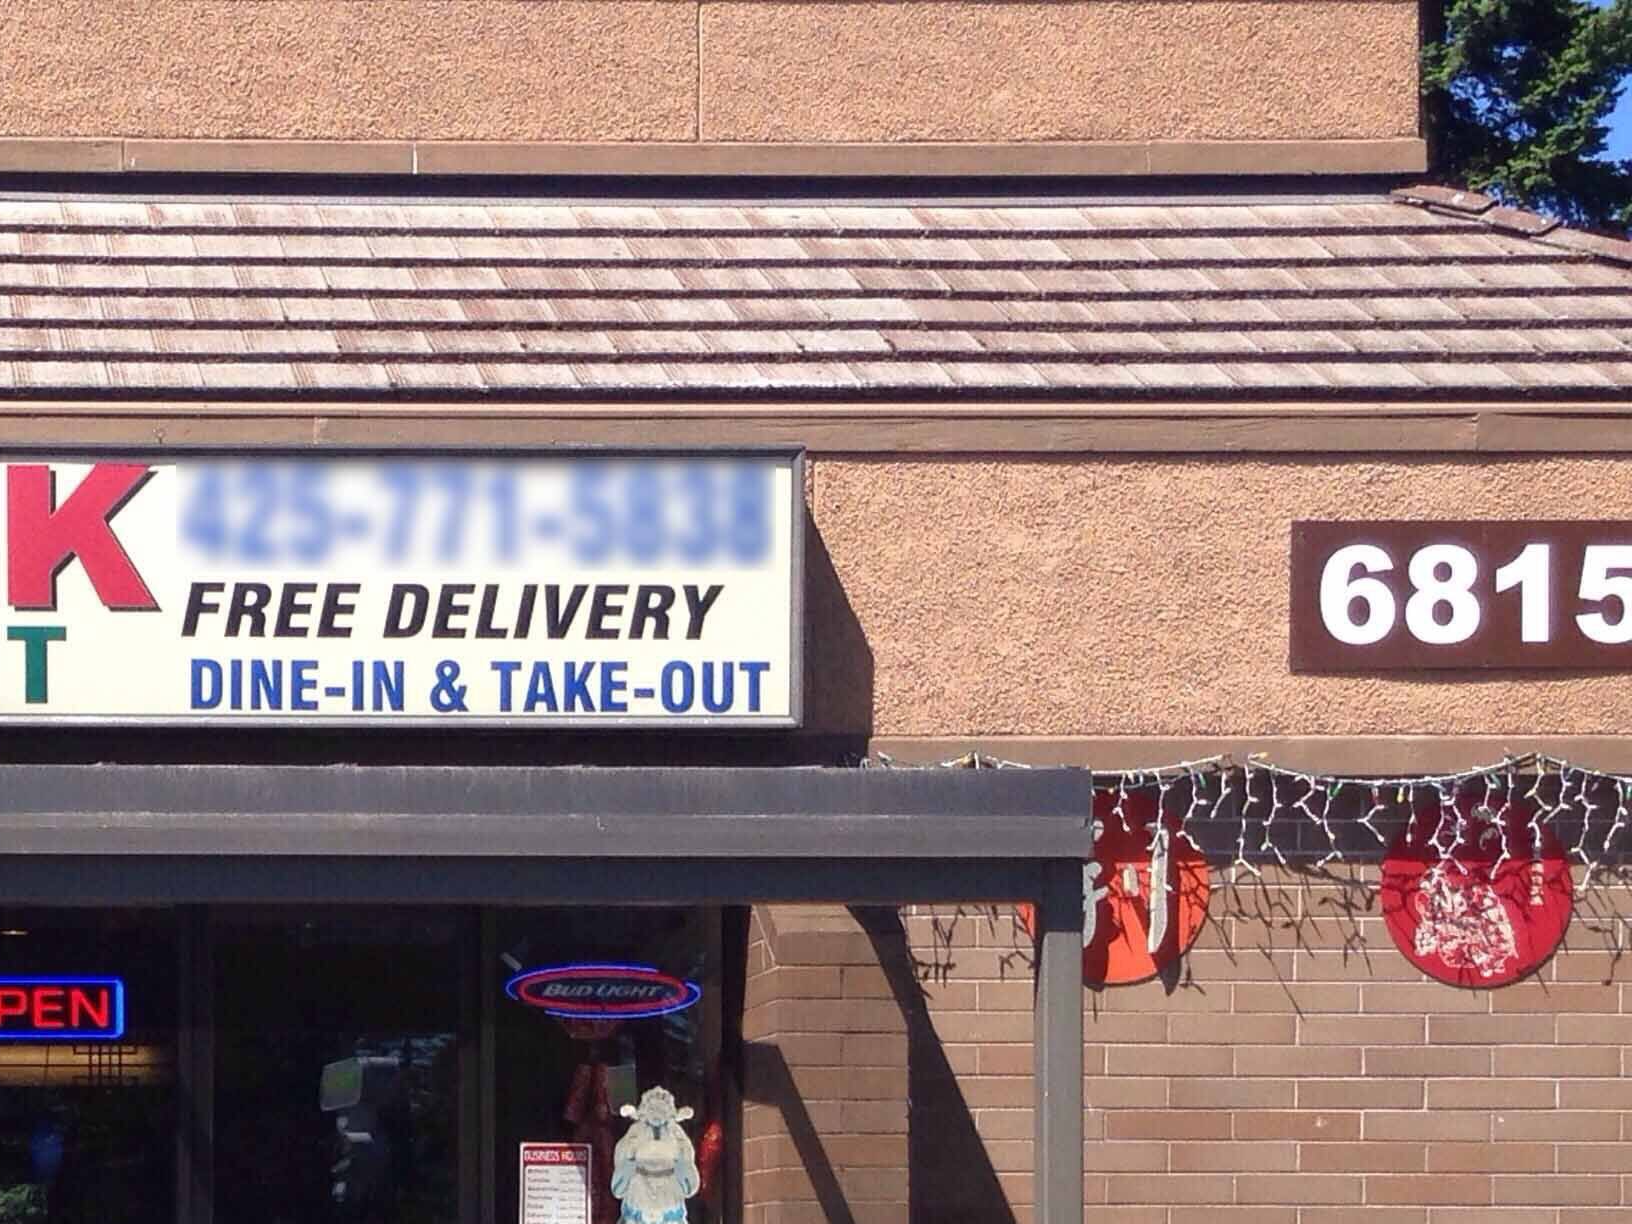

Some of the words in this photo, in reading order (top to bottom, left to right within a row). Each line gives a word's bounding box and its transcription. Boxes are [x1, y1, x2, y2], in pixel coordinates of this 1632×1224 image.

[181, 581, 361, 639] FREE
[383, 583, 725, 641] DELIVERY
[1319, 542, 1632, 645] 6815
[189, 658, 406, 712] DINE-IN
[429, 659, 470, 713] &
[490, 660, 771, 713] TAKE-OUT
